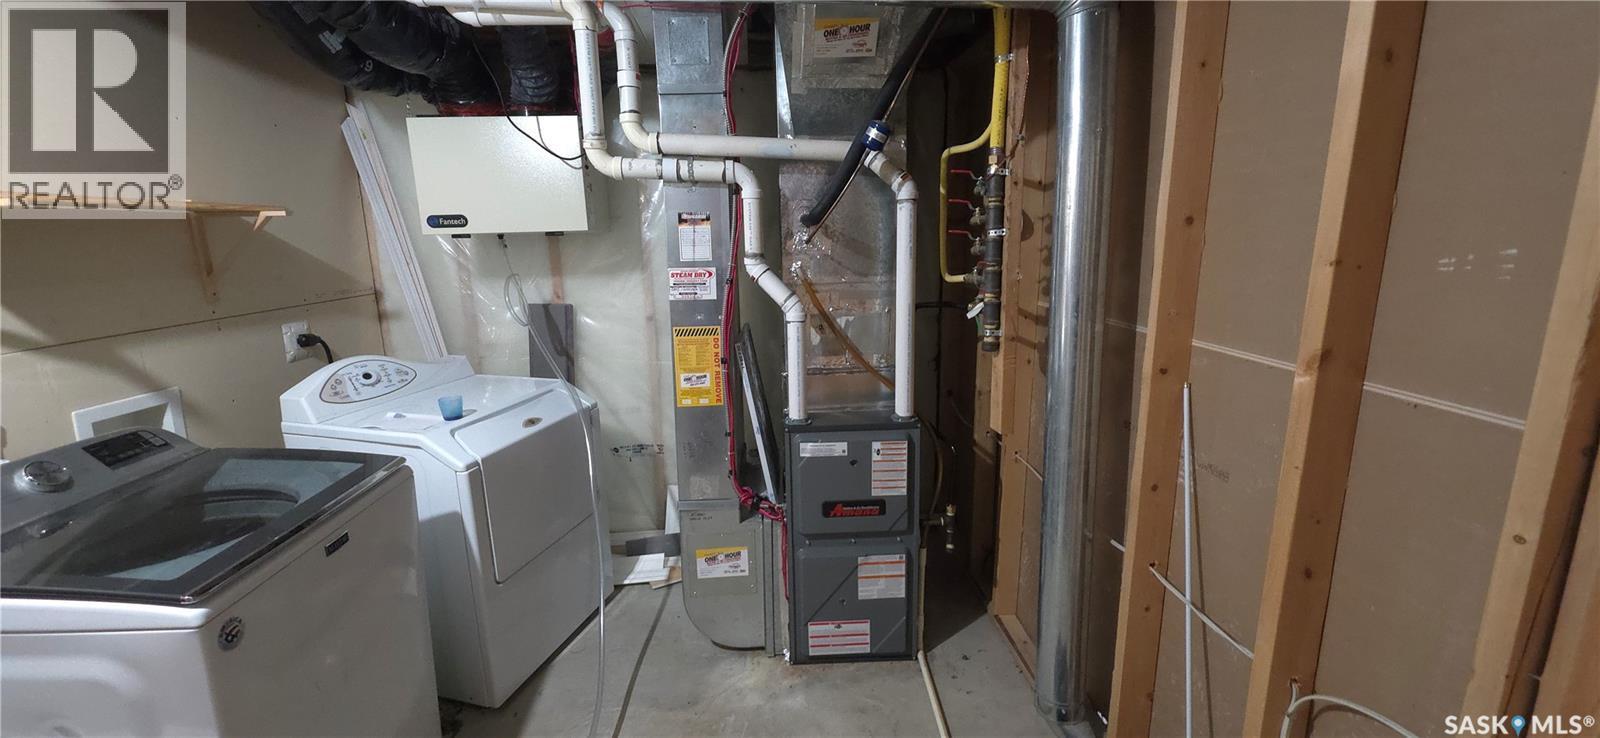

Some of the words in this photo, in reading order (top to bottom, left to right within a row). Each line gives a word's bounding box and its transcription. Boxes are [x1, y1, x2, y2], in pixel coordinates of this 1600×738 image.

[823, 28, 840, 38] ONE
[849, 23, 871, 34] HOUR
[439, 217, 466, 225] Fantech
[670, 271, 693, 279] STEAM
[713, 337, 720, 350] DO
[714, 369, 723, 404] REMOVE
[830, 503, 881, 517] Amana
[724, 550, 742, 559] HOUR
